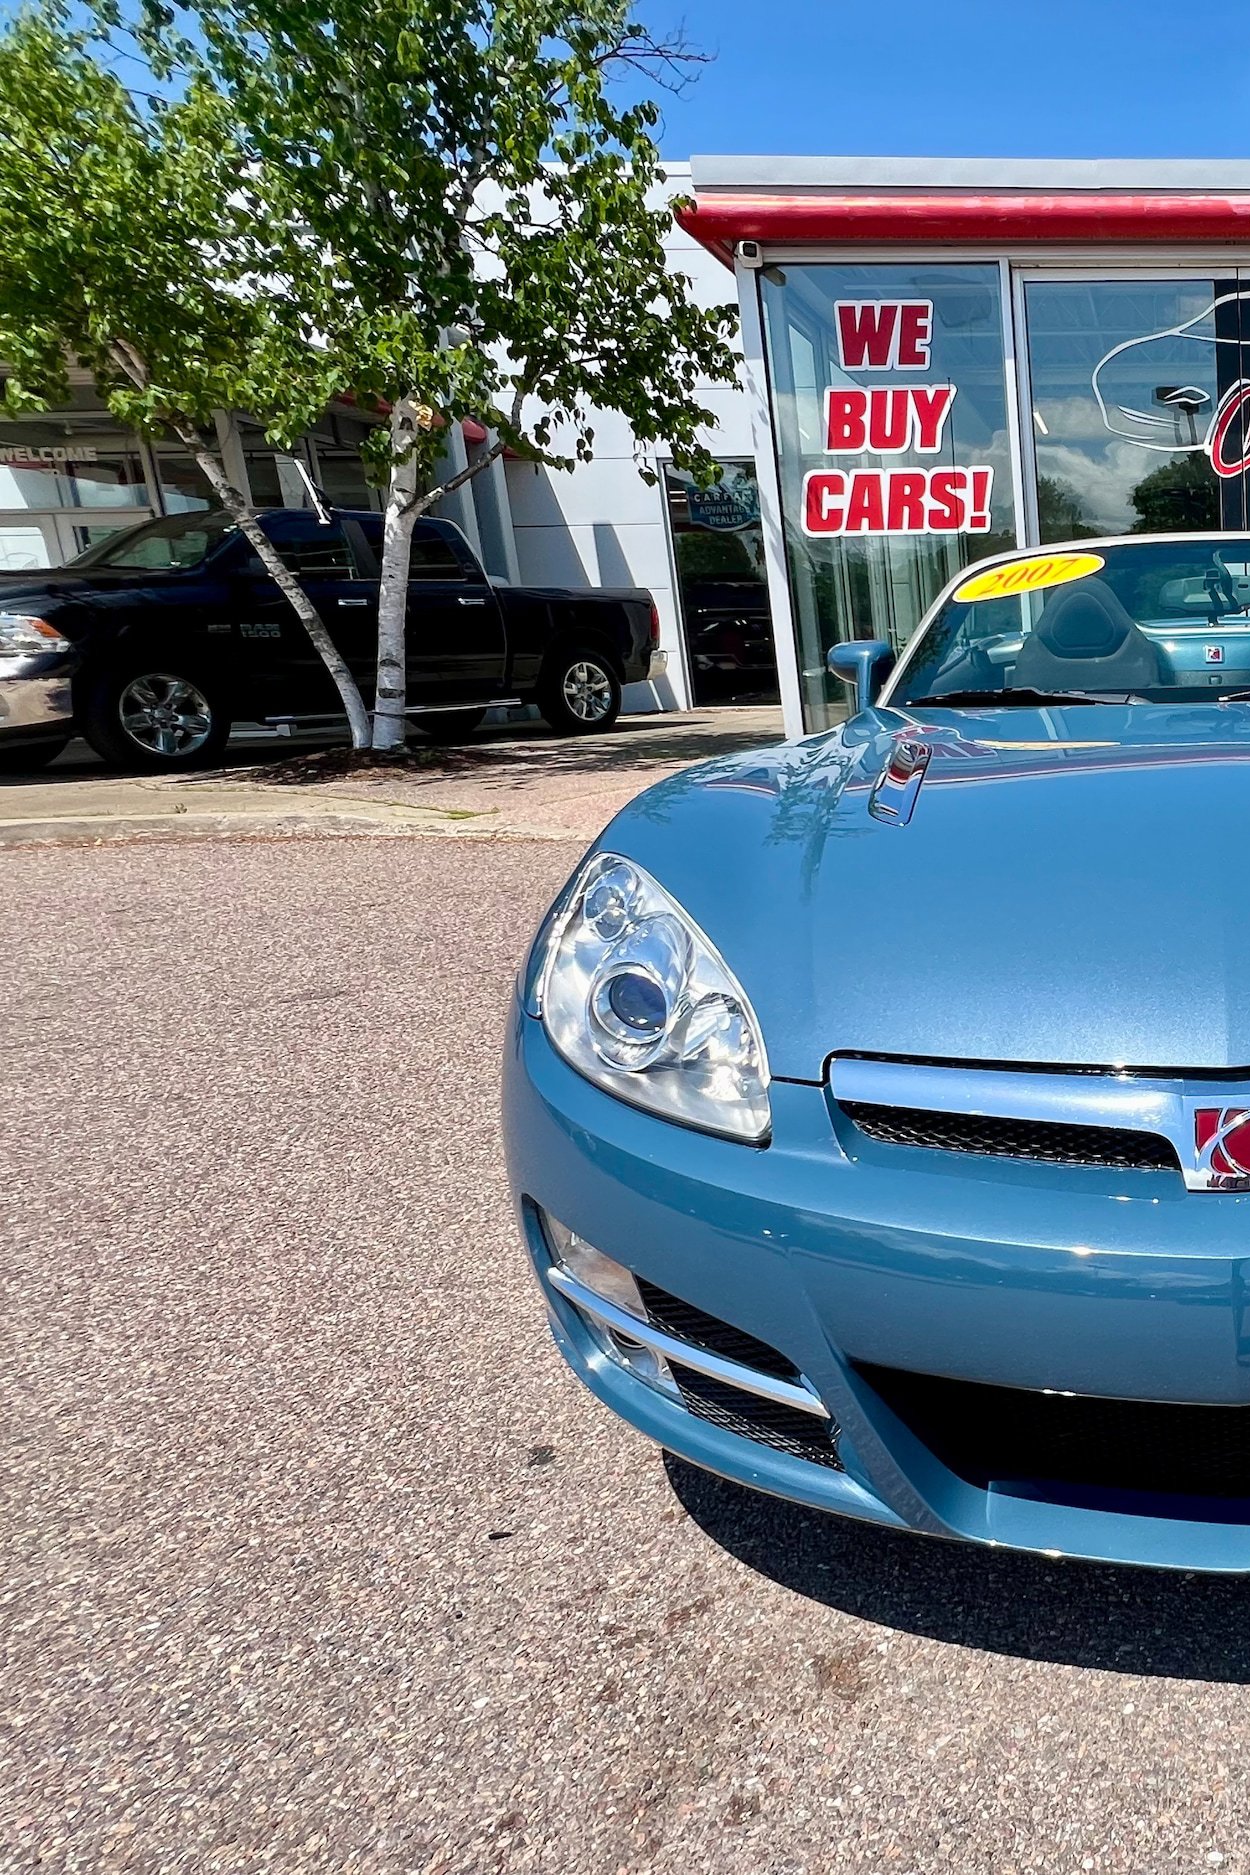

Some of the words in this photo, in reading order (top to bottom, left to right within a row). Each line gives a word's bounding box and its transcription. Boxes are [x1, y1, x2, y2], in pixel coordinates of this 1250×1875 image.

[836, 302, 931, 368] WE
[825, 386, 953, 452] BUY
[709, 515, 743, 525] DEALER
[804, 468, 991, 534] CARS!
[976, 558, 1080, 597] 2007
